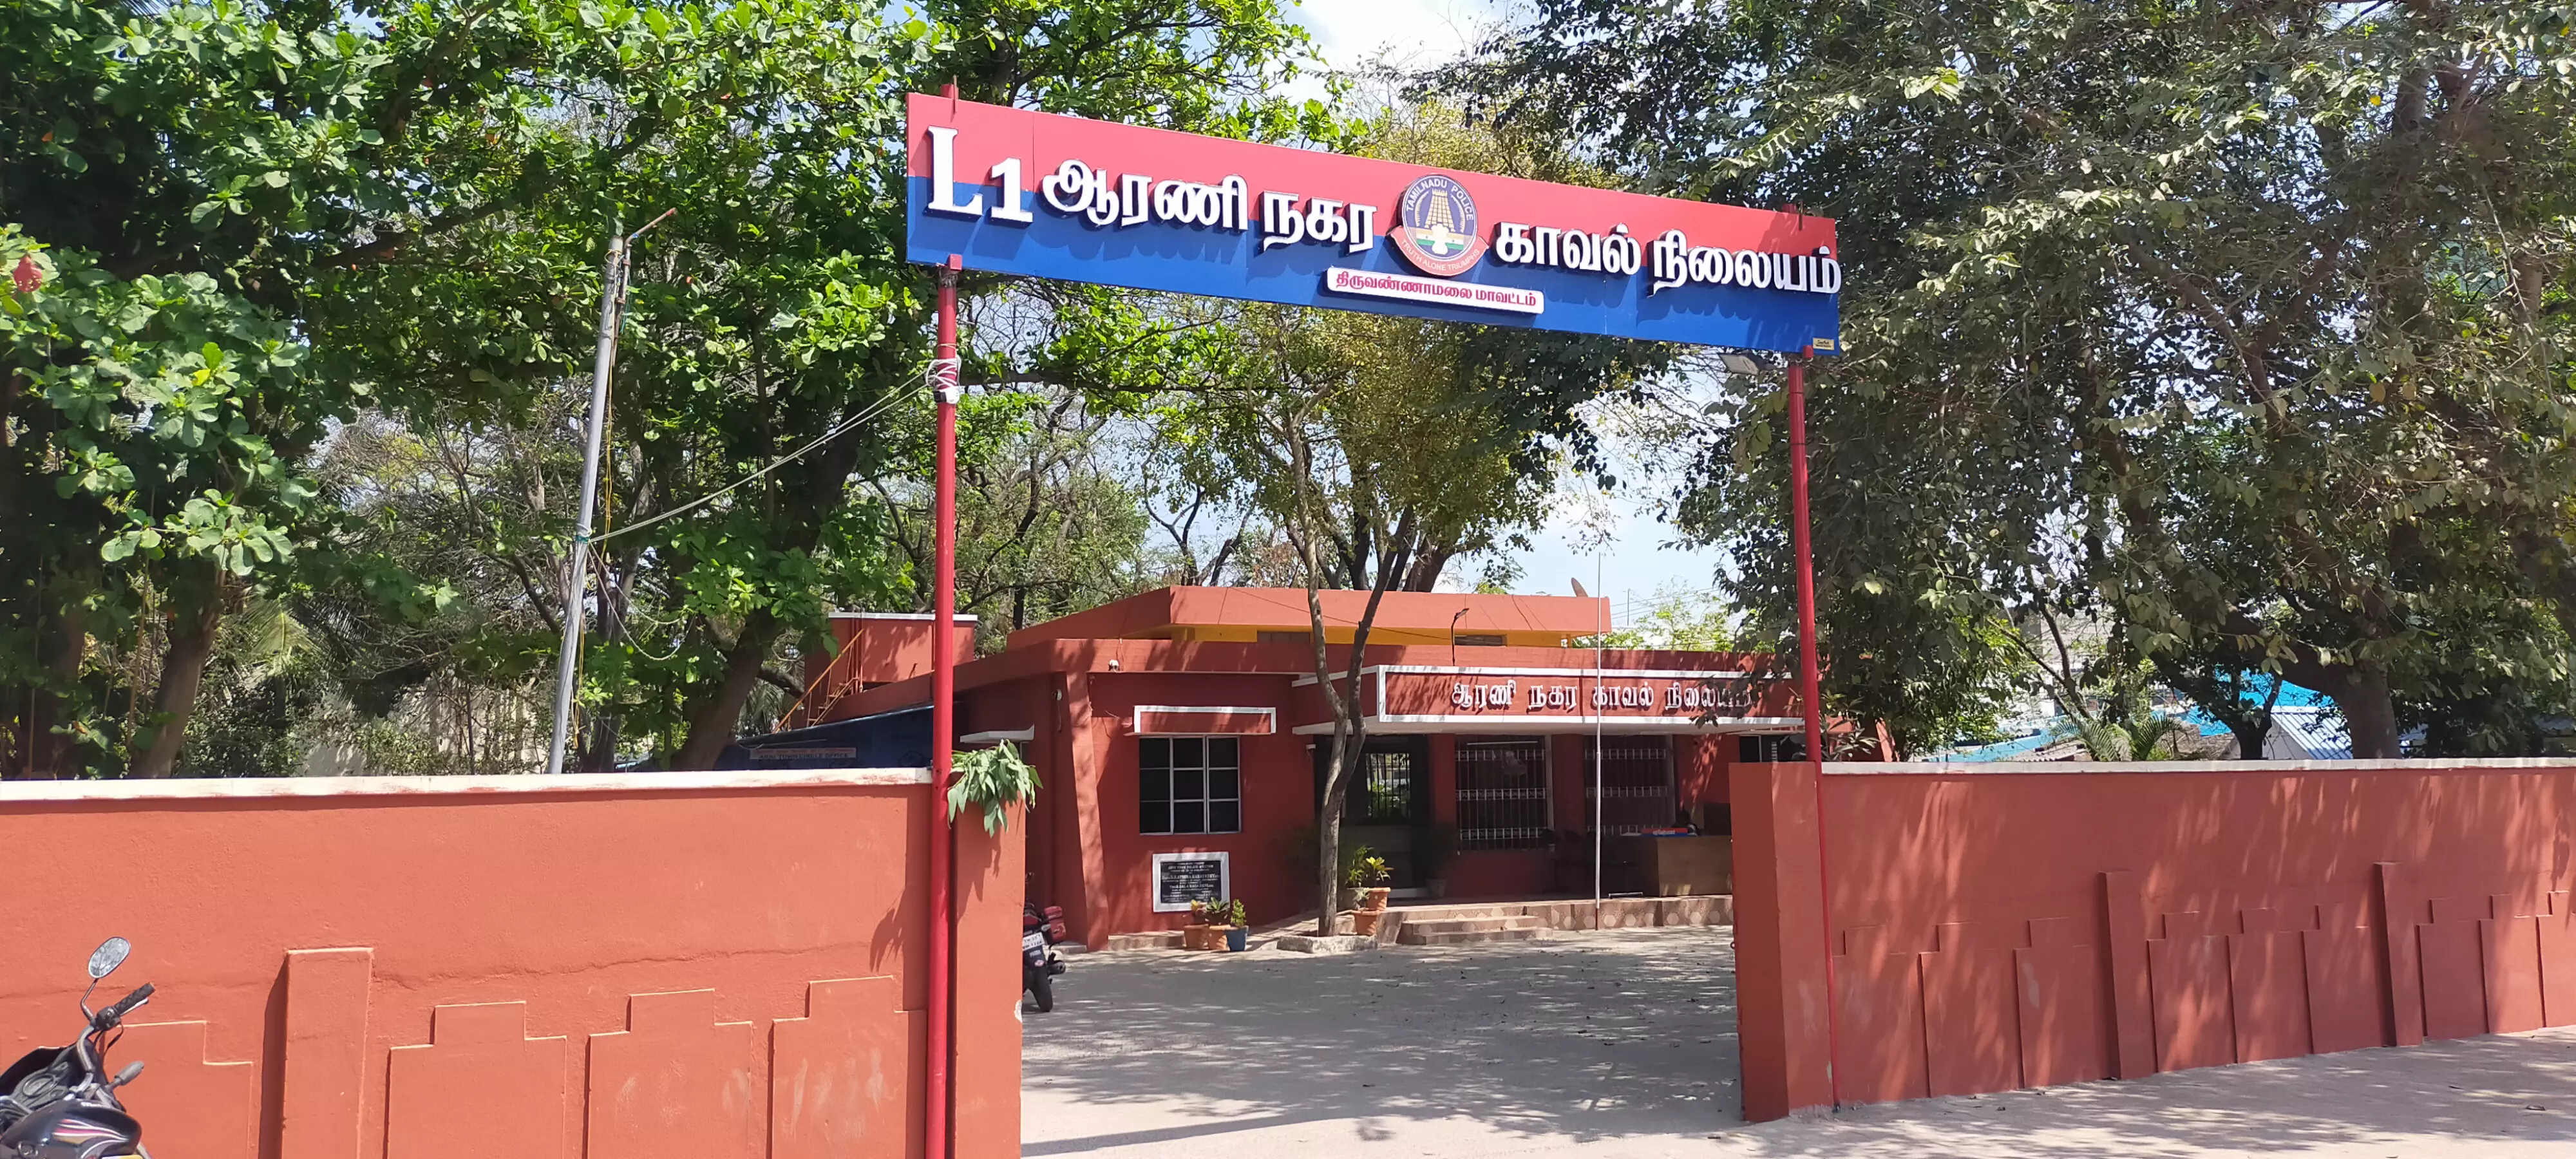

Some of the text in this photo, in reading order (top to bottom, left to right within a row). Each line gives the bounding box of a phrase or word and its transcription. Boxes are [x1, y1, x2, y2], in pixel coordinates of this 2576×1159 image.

[928, 126, 1842, 295] L1 ஆரணி நகர காவல் நிலையம்
[1406, 178, 1474, 221] TAMILNADU POLICE
[1401, 238, 1480, 270] TRUTH ALONE TRIUMPHS
[1336, 270, 1537, 306] திருவண்ணாமலை மாவட்டம்
[1452, 679, 1516, 708] ஆரணி
[1528, 684, 1578, 710] நகர
[1592, 681, 1654, 706] காவல்
